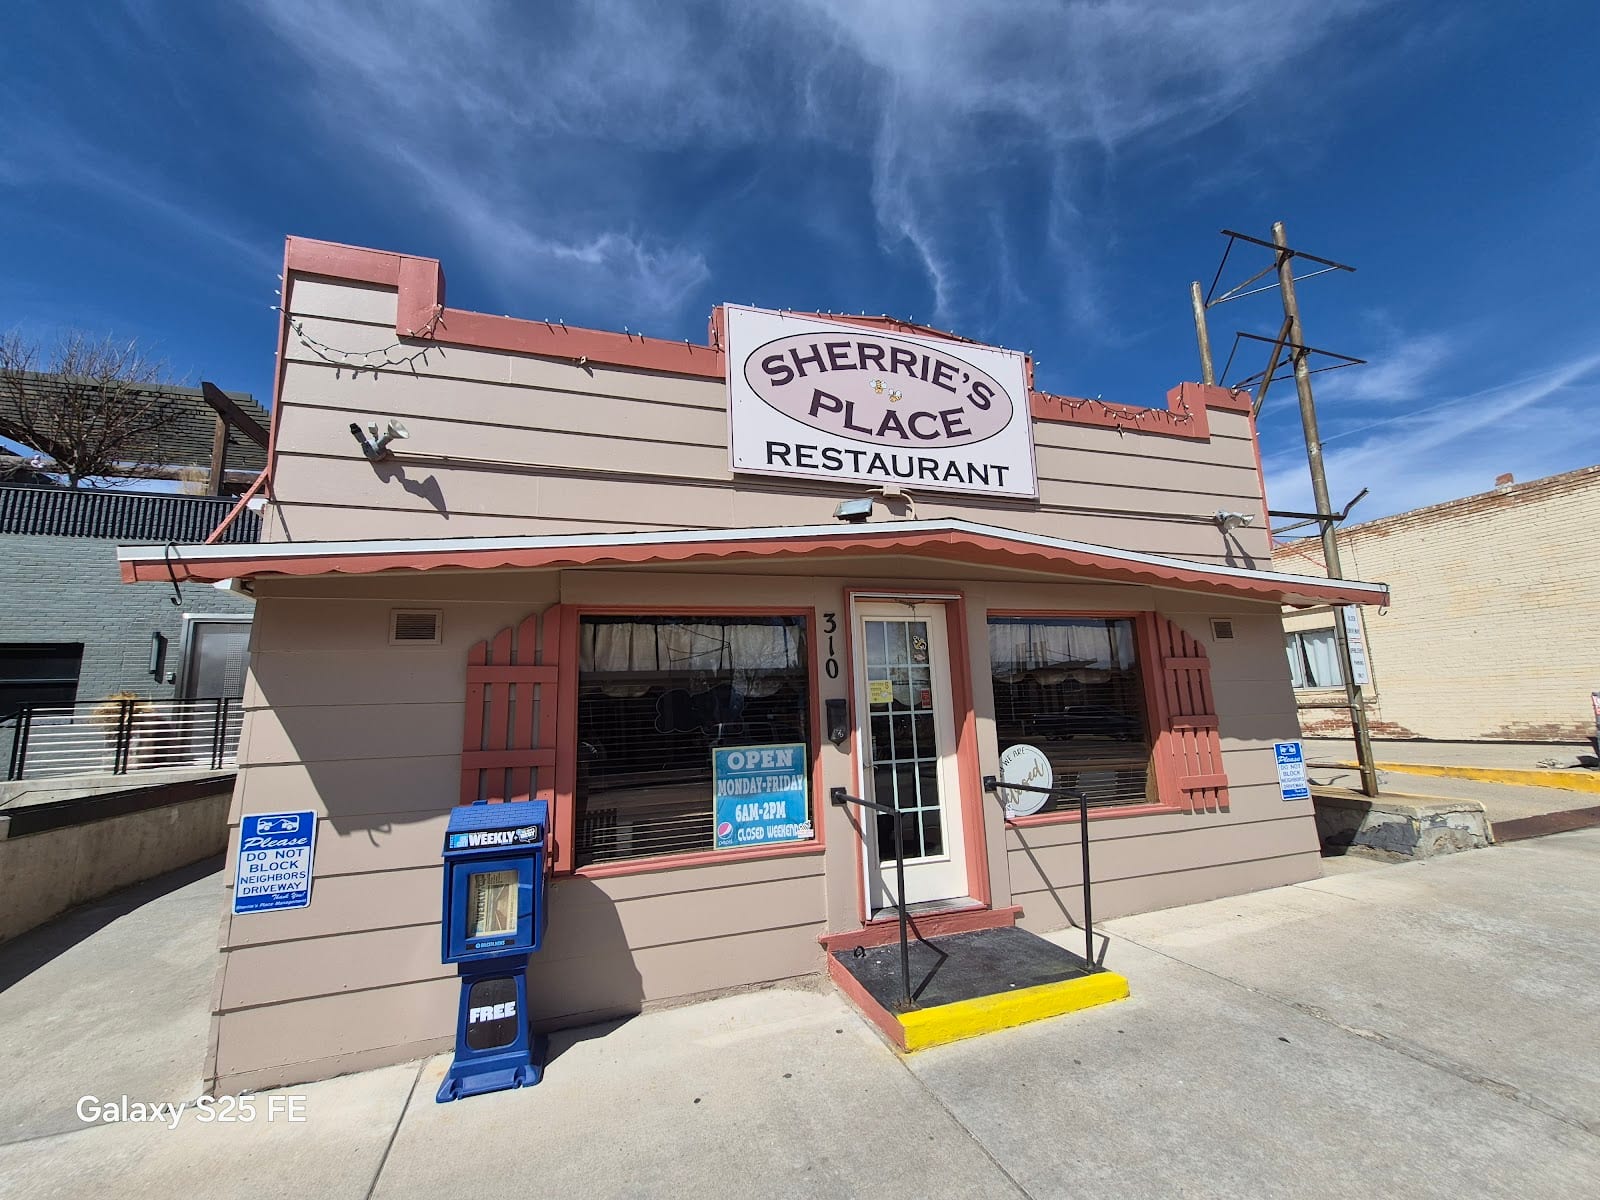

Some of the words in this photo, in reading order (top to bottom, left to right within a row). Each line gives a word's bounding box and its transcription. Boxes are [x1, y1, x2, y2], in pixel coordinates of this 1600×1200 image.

[761, 340, 995, 411] SHERRIE'S
[807, 388, 972, 441] PLACE
[766, 440, 1009, 487] RESTAURANT
[823, 613, 839, 679] 310
[727, 749, 794, 770] OPEN
[717, 774, 804, 797] MONDAY-FRIDAY
[735, 801, 787, 822] 6AM-2PM
[242, 836, 308, 850] Please
[468, 830, 516, 847] WEEKLY
[737, 826, 765, 841] CLOSED
[246, 851, 267, 862] DO
[275, 848, 305, 859] NOT
[249, 860, 299, 873] BLOCK
[240, 871, 306, 884] NEIGHBORS
[243, 882, 302, 895] DRIVEWAY
[469, 1001, 516, 1024] FREE
